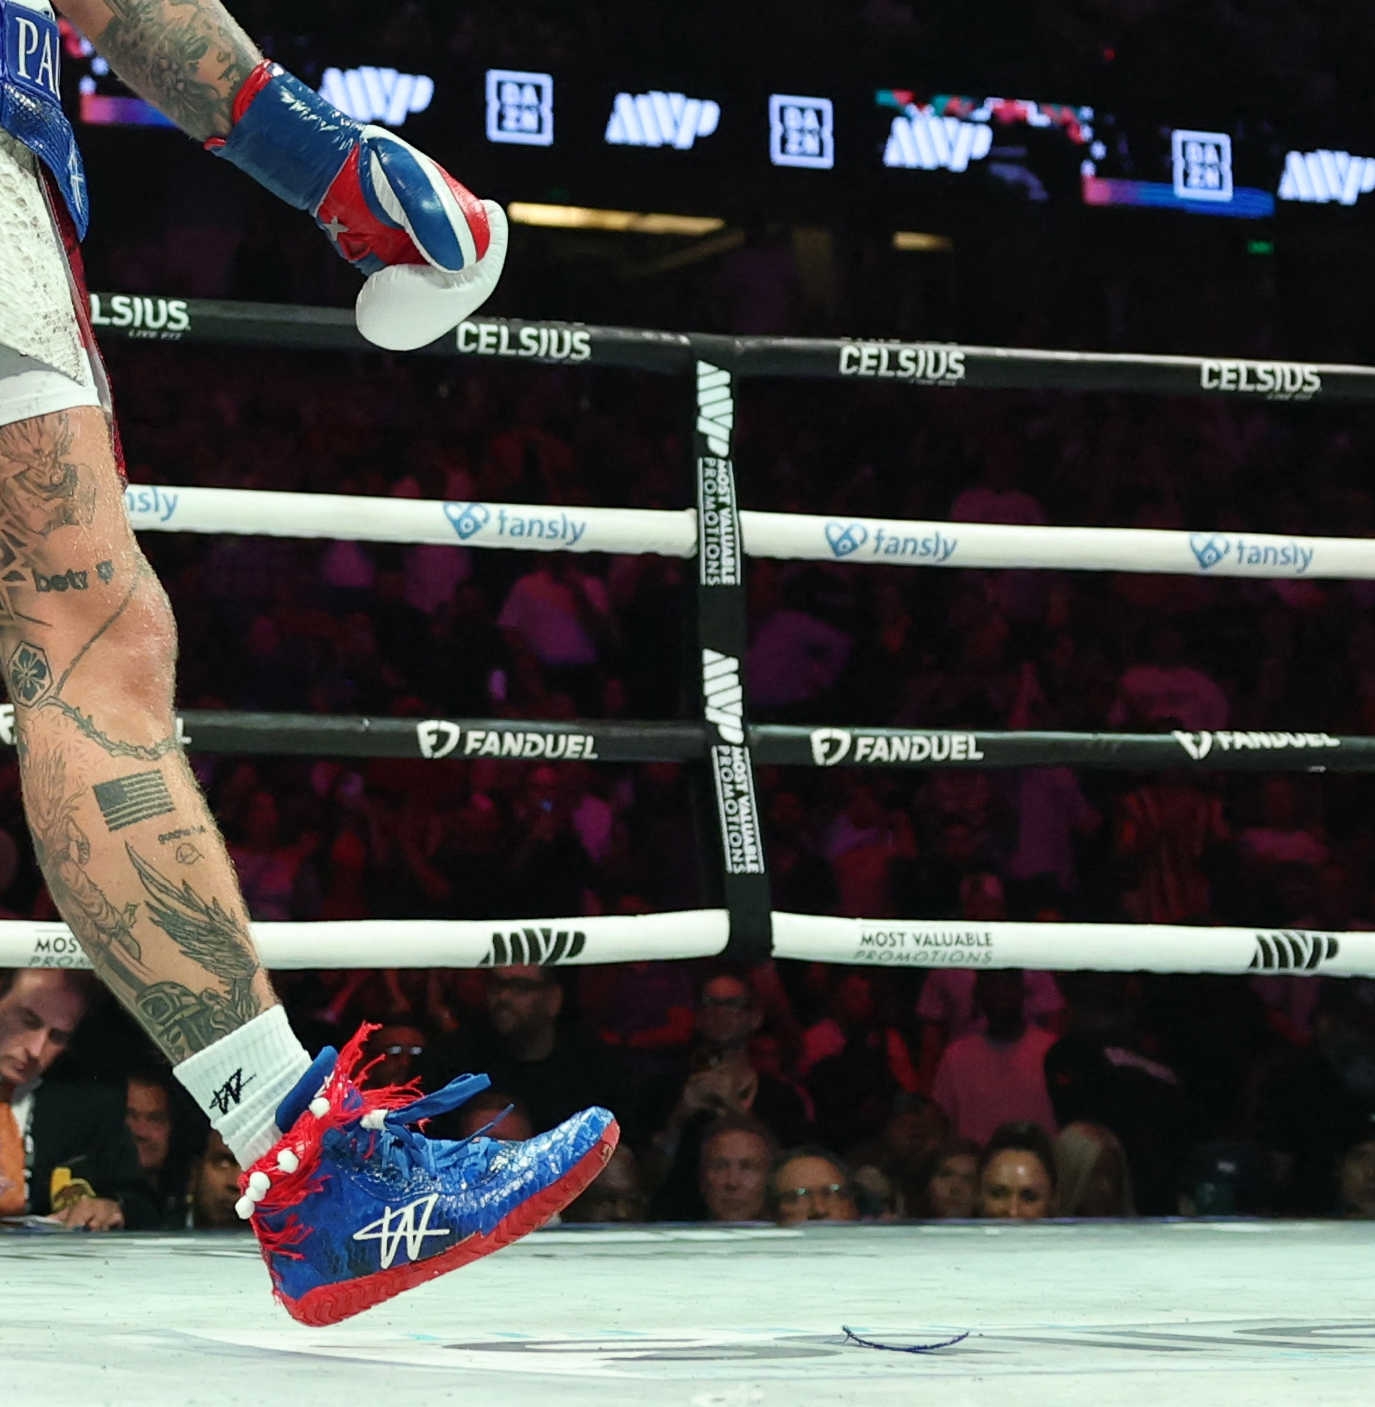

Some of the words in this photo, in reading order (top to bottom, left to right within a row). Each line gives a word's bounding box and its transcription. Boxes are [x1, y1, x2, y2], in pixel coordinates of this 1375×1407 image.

[90, 293, 190, 331] LSIUS
[457, 321, 592, 361] CELSIUS
[840, 346, 966, 380] CELSIUS
[1200, 360, 1322, 393] CELSIUS
[716, 458, 731, 504] MOST
[125, 487, 179, 522] nsly
[703, 458, 720, 586] PROMOTIONS
[498, 506, 587, 545] fansly
[873, 527, 958, 562] fansly
[1237, 538, 1314, 573] fansly
[464, 730, 599, 760] FANDUEL
[855, 734, 983, 762] FANDUEL
[731, 746, 749, 794] MOST
[718, 746, 746, 874] PROMOTIONS
[35, 937, 83, 954] MOS
[860, 931, 906, 947] MOST
[914, 931, 993, 947] VALUABLE
[854, 949, 993, 965] PROMOTIONS
